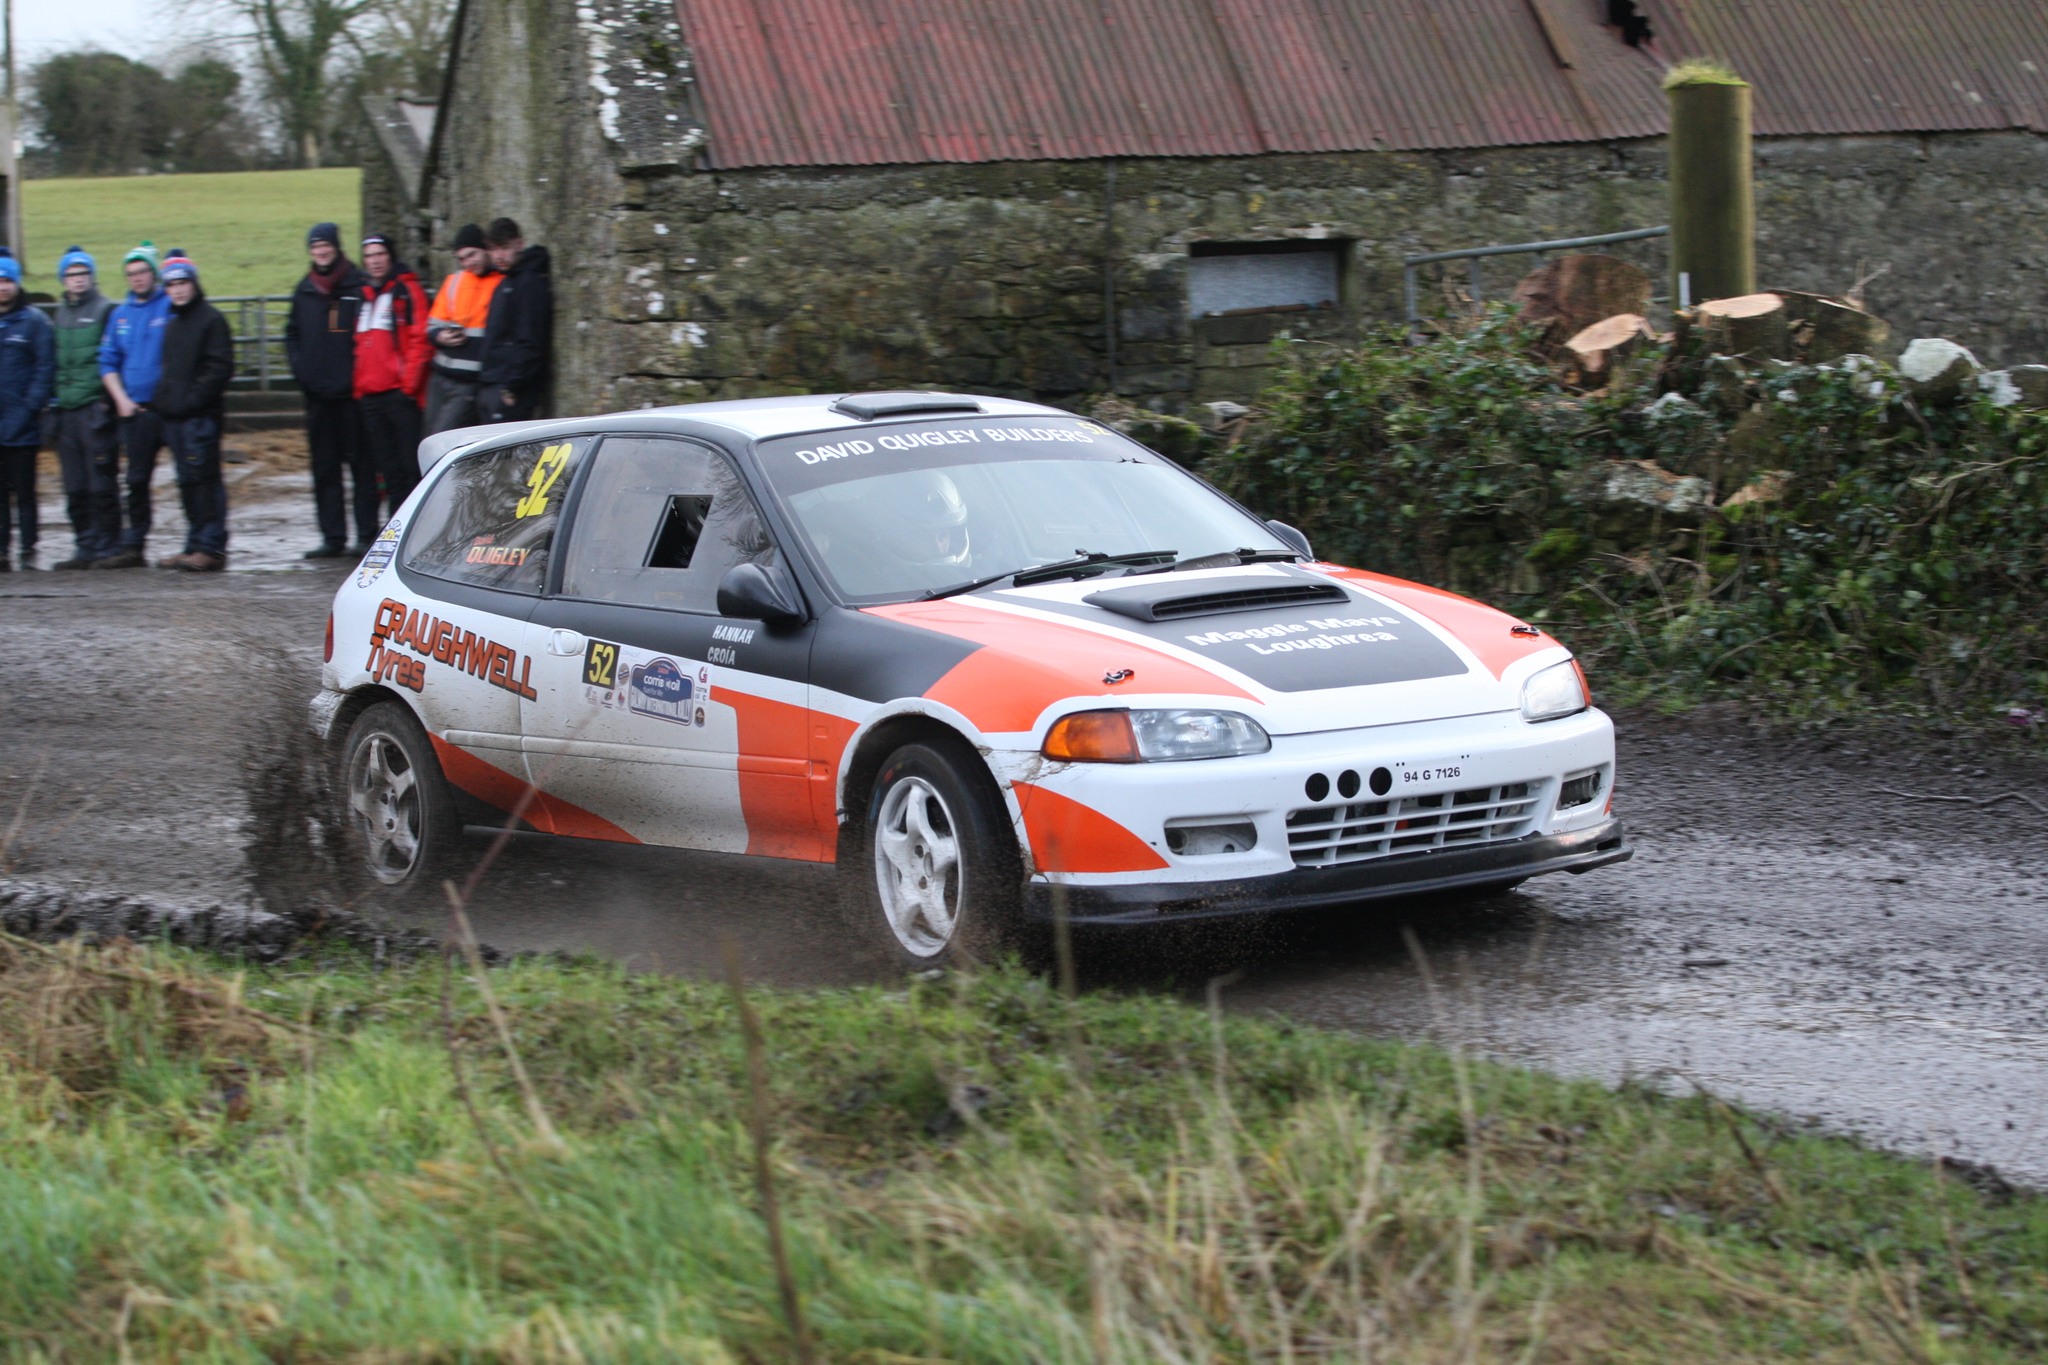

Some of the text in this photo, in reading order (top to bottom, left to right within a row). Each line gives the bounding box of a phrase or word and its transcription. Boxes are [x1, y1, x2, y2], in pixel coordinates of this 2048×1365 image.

[1075, 422, 1113, 436] 52
[795, 428, 1095, 466] DAVID QUIGLEY BUILDERS
[515, 443, 573, 519] 52
[466, 546, 531, 566] QUIGLEY
[712, 624, 755, 645] HANNAH
[1184, 615, 1401, 646] Maggie Mays
[1245, 630, 1399, 655] Loughrea
[365, 632, 426, 694] Tyres
[374, 597, 538, 702] CRAUGHWELL
[707, 645, 736, 666] CROÍA
[588, 643, 615, 686] 52
[1403, 766, 1461, 782] 94 G 7126
